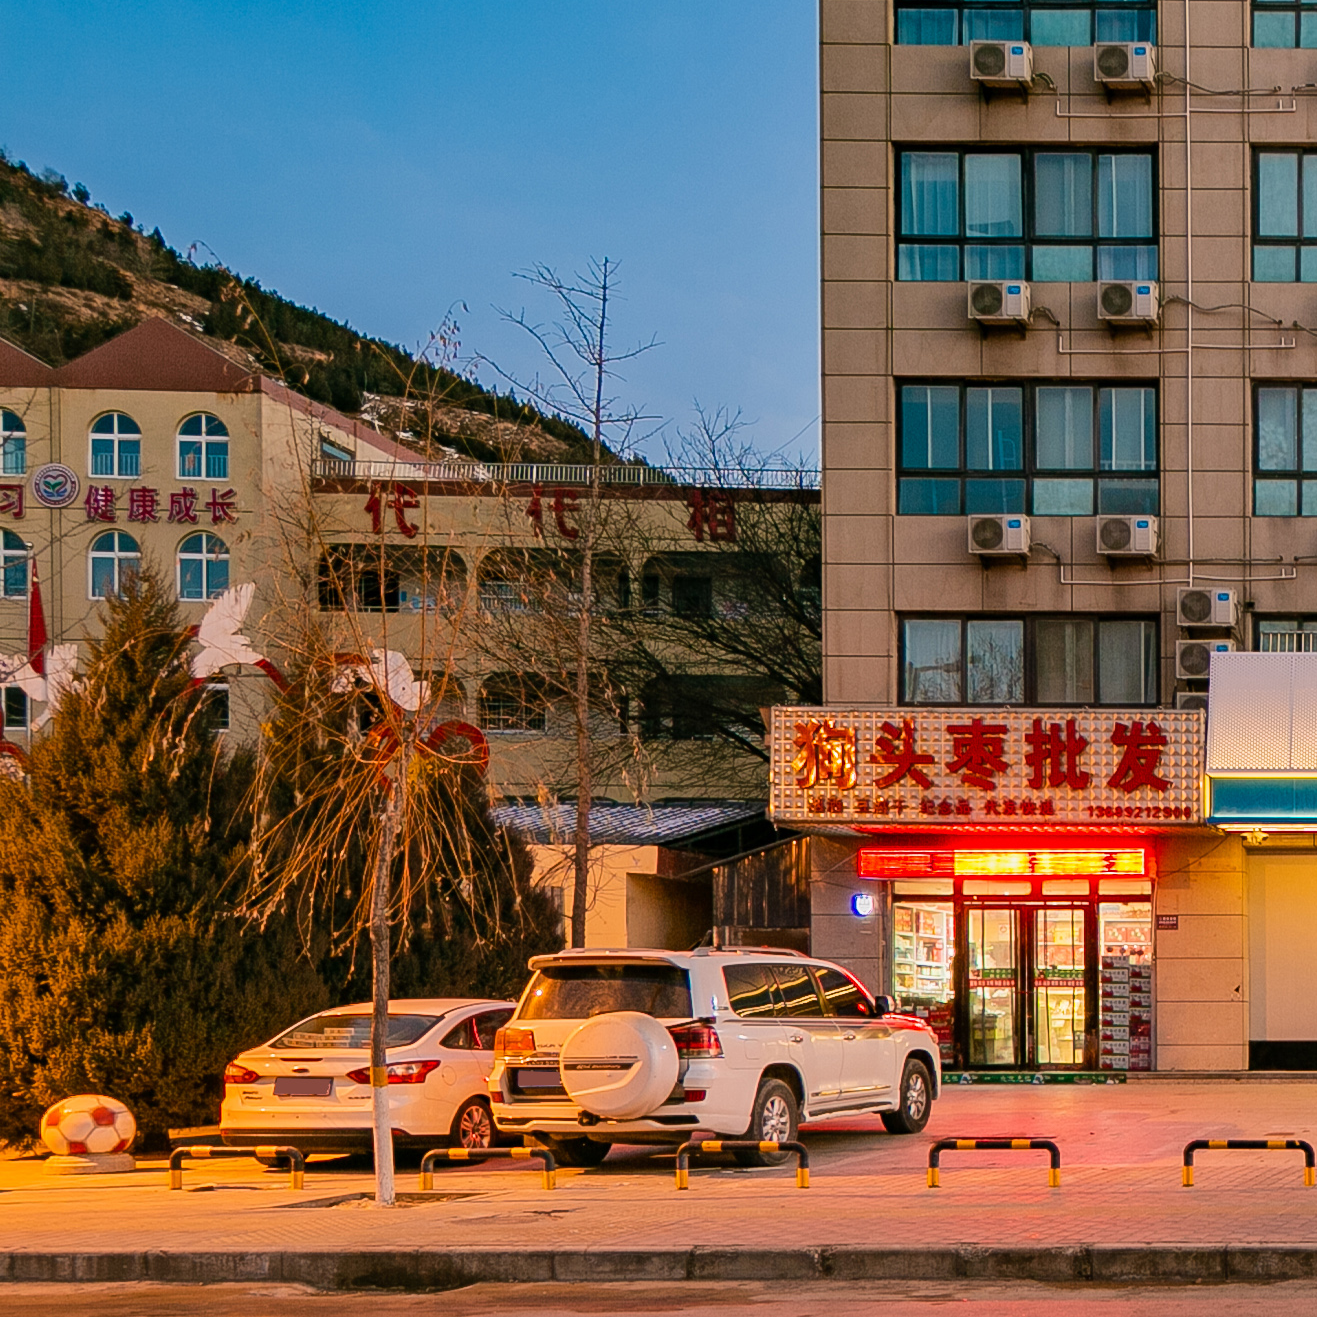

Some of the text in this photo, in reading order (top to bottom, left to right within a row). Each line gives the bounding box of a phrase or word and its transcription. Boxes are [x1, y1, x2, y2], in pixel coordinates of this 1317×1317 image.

[85, 484, 238, 525] 健康成长
[792, 717, 1174, 792] 狗头枣批发
